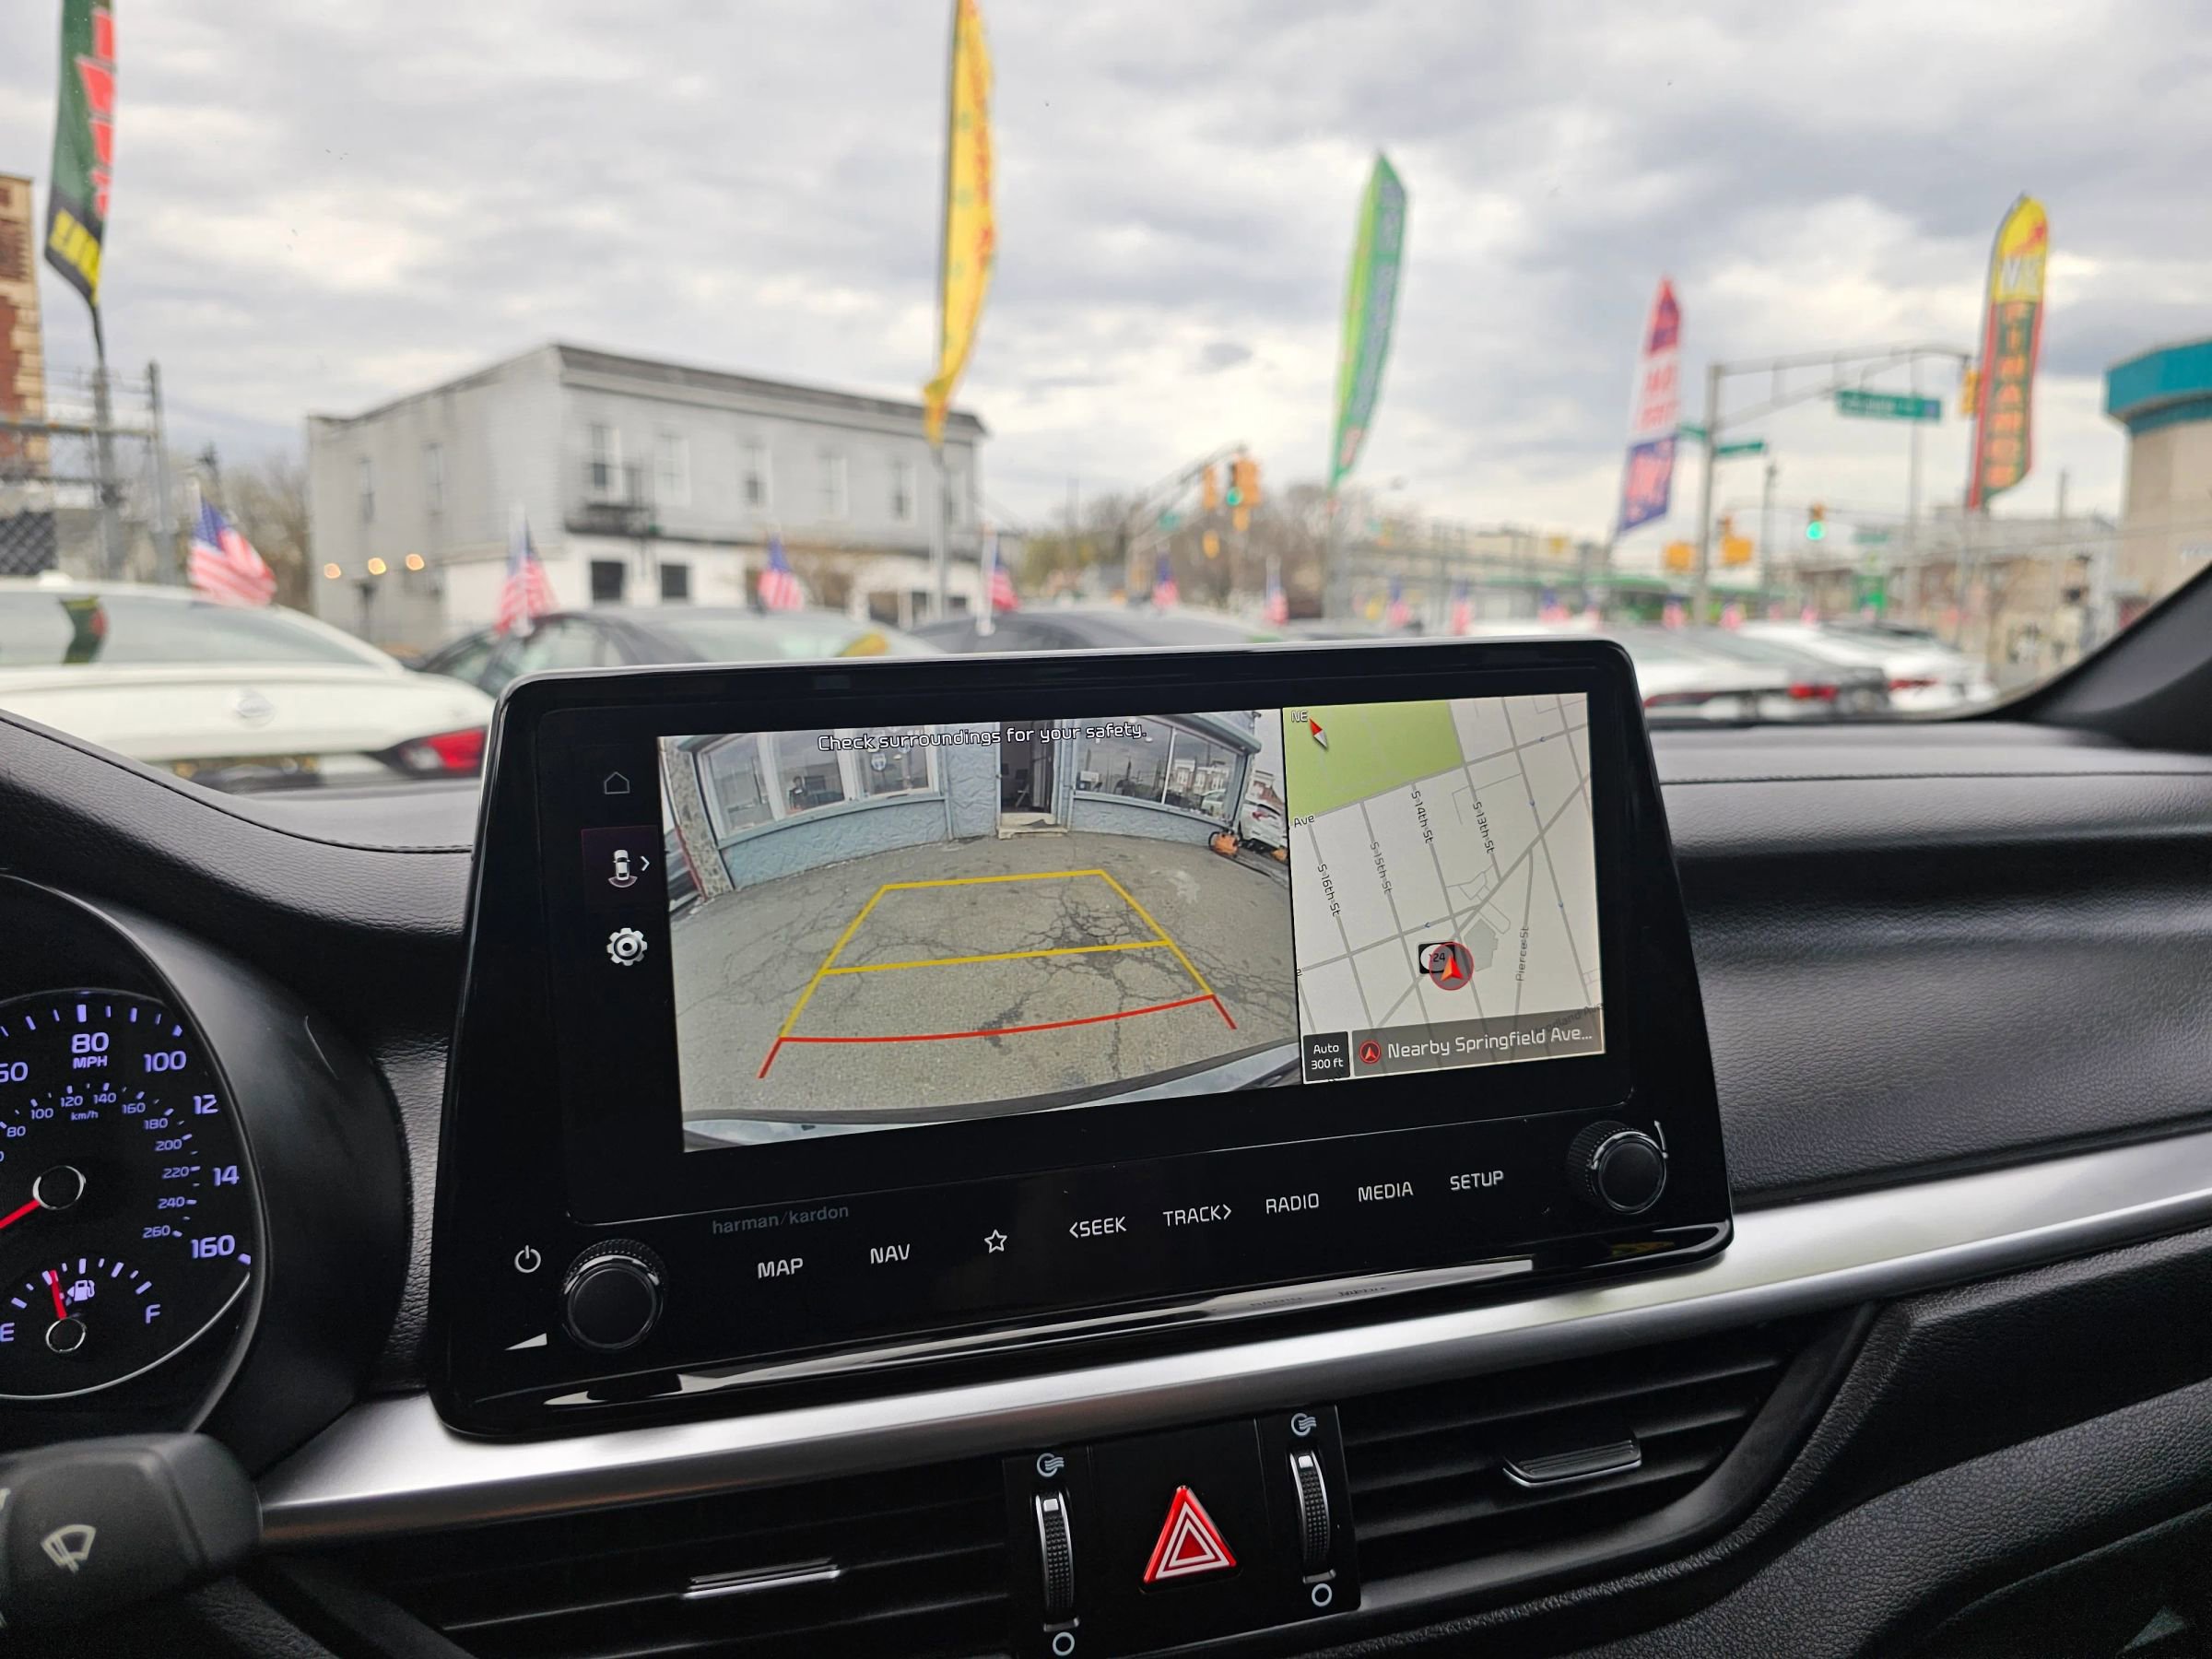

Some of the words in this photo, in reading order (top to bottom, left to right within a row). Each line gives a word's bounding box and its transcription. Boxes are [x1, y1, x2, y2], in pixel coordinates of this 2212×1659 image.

[1291, 710, 1309, 724] NE
[818, 734, 876, 752] Check
[878, 729, 1002, 749] surroundings
[1006, 727, 1035, 743] for
[1040, 727, 1081, 744] your
[1086, 722, 1147, 739] safety.
[1411, 790, 1421, 799] S
[1473, 801, 1483, 810] S
[1293, 815, 1315, 828] Ave
[1415, 803, 1429, 828] 14th
[1476, 812, 1490, 838] 13th
[1422, 830, 1434, 844] St
[1370, 841, 1380, 851] S
[1484, 840, 1495, 853] St
[1317, 864, 1327, 874] S
[1373, 854, 1387, 878] 15th
[1321, 875, 1335, 900] 16th
[1382, 880, 1394, 895] St
[1329, 902, 1341, 917] St
[1519, 925, 1530, 941] St
[1515, 943, 1529, 982] Pierce
[71, 1031, 110, 1053] 80
[1313, 1043, 1340, 1054] Auto
[1388, 1041, 1450, 1059] Nearby
[1455, 1030, 1546, 1053] Springfield
[1550, 1027, 1594, 1043] Ave...
[73, 1055, 108, 1069] MPH
[144, 1051, 187, 1073] 100
[1311, 1059, 1331, 1070] 300
[1333, 1058, 1344, 1068] ft
[60, 1095, 84, 1107] 120
[93, 1092, 117, 1104] 140
[30, 1108, 54, 1120] 100
[122, 1102, 146, 1114] 160
[71, 1110, 99, 1121] km/h
[143, 1117, 169, 1130] 180
[6, 1125, 27, 1137] 80
[155, 1139, 182, 1151] 200
[161, 1166, 190, 1179] 220
[1450, 1170, 1505, 1191] SETUP
[1357, 1181, 1414, 1203] MEDIA
[158, 1196, 185, 1209] 240
[1265, 1193, 1320, 1215] RADIO
[712, 1205, 850, 1235] harman/kardon
[142, 1225, 171, 1239] 260
[191, 1234, 235, 1259] 160
[869, 1243, 911, 1265] NAV
[757, 1257, 804, 1279] MAP
[145, 1303, 161, 1324] F
[0, 1323, 15, 1342] E
